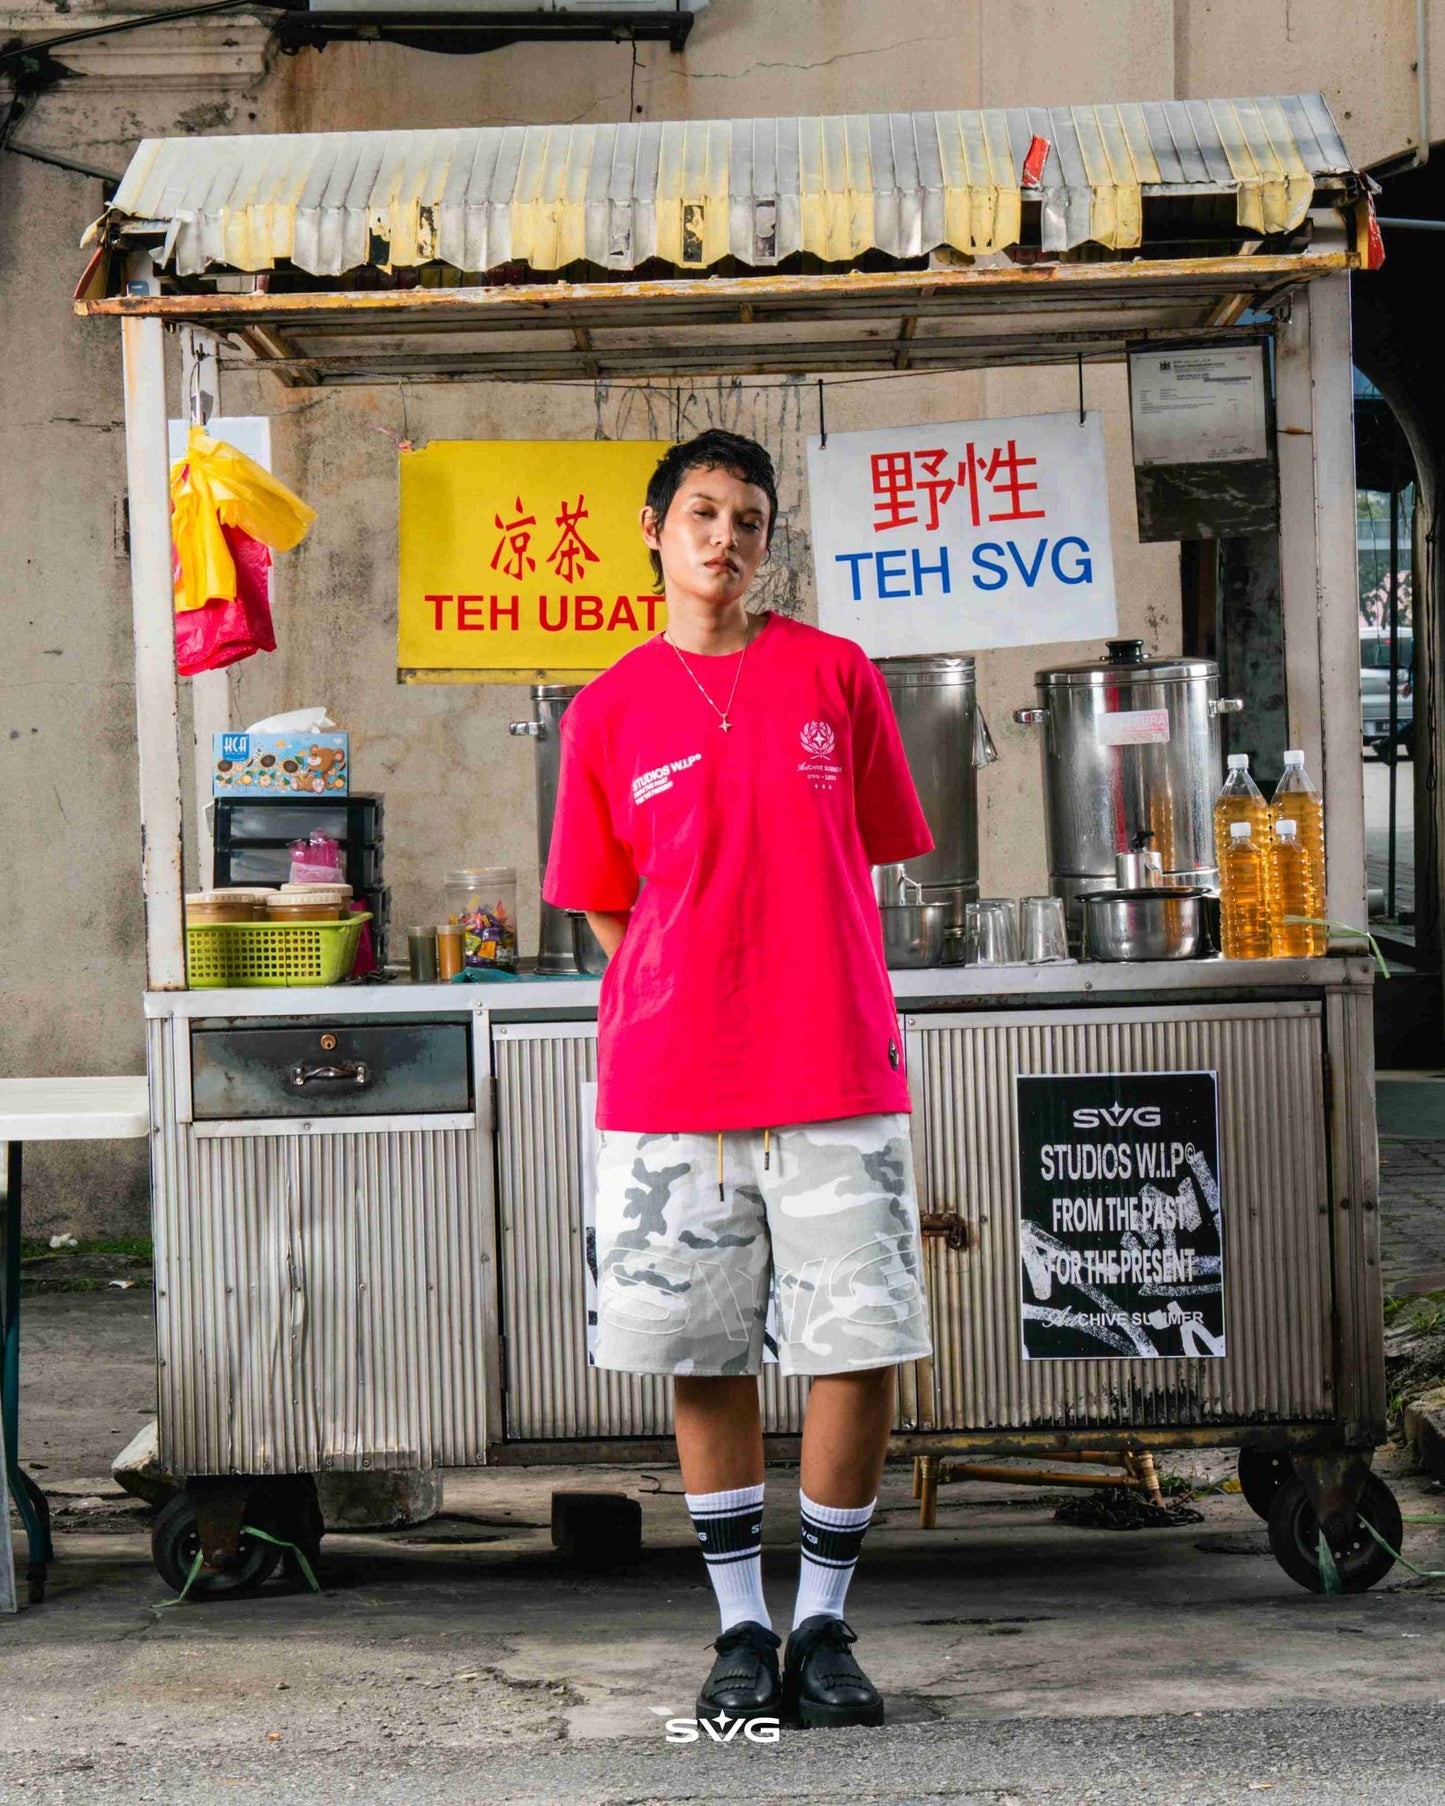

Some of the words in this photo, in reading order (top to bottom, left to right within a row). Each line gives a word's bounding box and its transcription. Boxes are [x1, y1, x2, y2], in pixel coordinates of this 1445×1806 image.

[870, 440, 1045, 533] 野性
[835, 545, 951, 601] TEH
[972, 536, 1093, 591] SVG
[424, 595, 519, 632] TEH
[538, 595, 666, 632] UBAT
[632, 764, 671, 792] STUDIOS
[1072, 1104, 1162, 1129] SVG
[1040, 1142, 1132, 1180] STUDIOS
[1052, 1197, 1104, 1233] FROM
[1106, 1196, 1139, 1232] THE
[1142, 1195, 1187, 1231] PAST
[1048, 1249, 1083, 1285] FOR
[1084, 1249, 1119, 1284] THE
[1120, 1248, 1196, 1284] PRESENT
